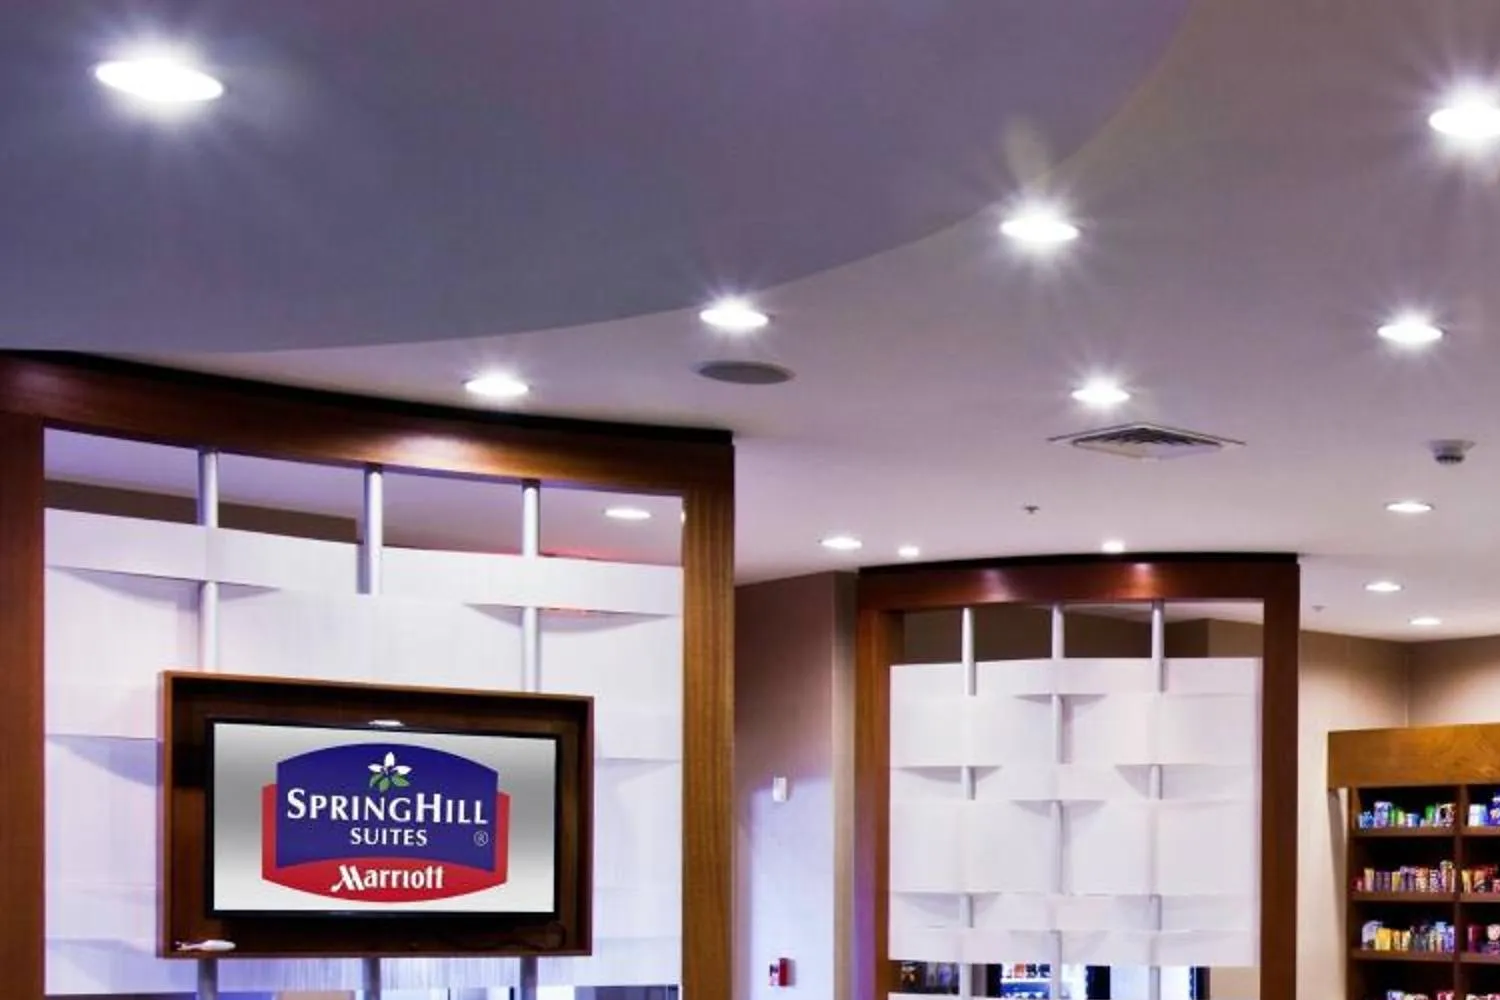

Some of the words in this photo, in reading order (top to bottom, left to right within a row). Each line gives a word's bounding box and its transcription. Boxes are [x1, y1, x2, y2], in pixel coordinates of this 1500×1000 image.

[287, 788, 489, 825] SPRINGHILL
[350, 827, 428, 846] SUITES
[330, 864, 444, 892] Marriott
